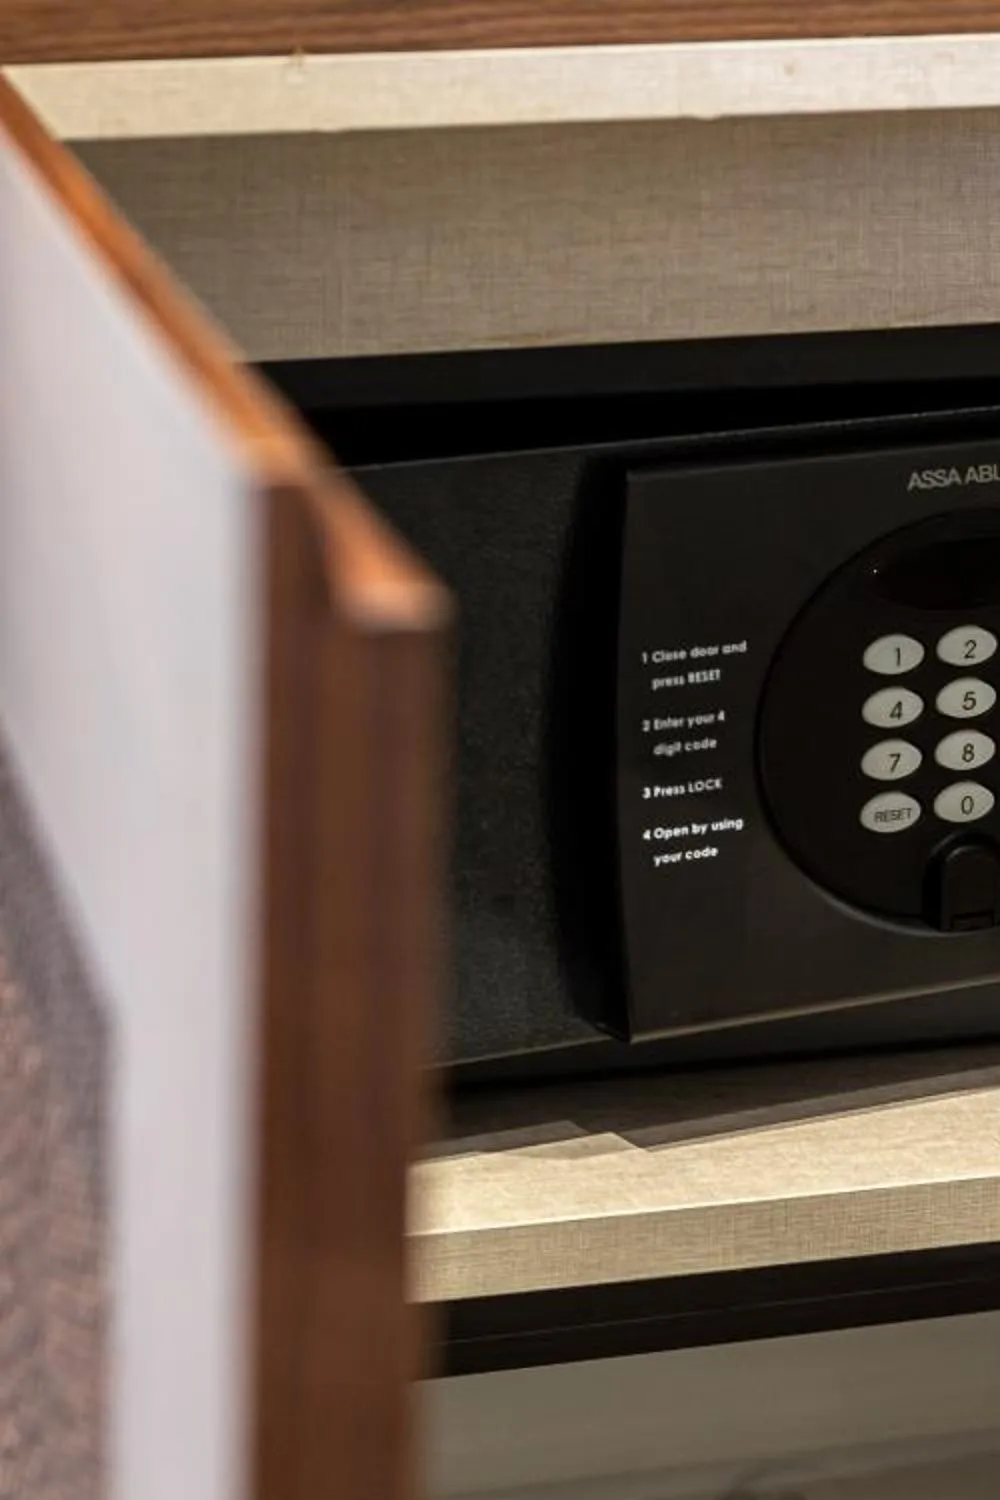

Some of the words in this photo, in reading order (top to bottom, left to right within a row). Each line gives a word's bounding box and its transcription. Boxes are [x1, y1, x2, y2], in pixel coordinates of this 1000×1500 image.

[907, 466, 961, 491] ASSA
[722, 640, 748, 654] and
[895, 647, 901, 667] 1
[964, 639, 977, 659] 2
[652, 677, 685, 690] press
[687, 669, 721, 684] RESET
[889, 701, 903, 720] 4
[962, 691, 977, 710] 5
[653, 717, 684, 730] Enter
[687, 713, 716, 728] your
[962, 743, 974, 762] 8
[888, 753, 901, 773] 7
[643, 787, 651, 799] 3
[653, 784, 685, 797] Press
[688, 777, 723, 793] LOCK
[874, 808, 913, 822] RESET
[961, 796, 974, 814] 0
[643, 830, 652, 840] 4
[653, 826, 689, 840] Open
[691, 822, 709, 836] by
[711, 817, 744, 832] using
[653, 854, 682, 866] your
[684, 846, 719, 860] code
